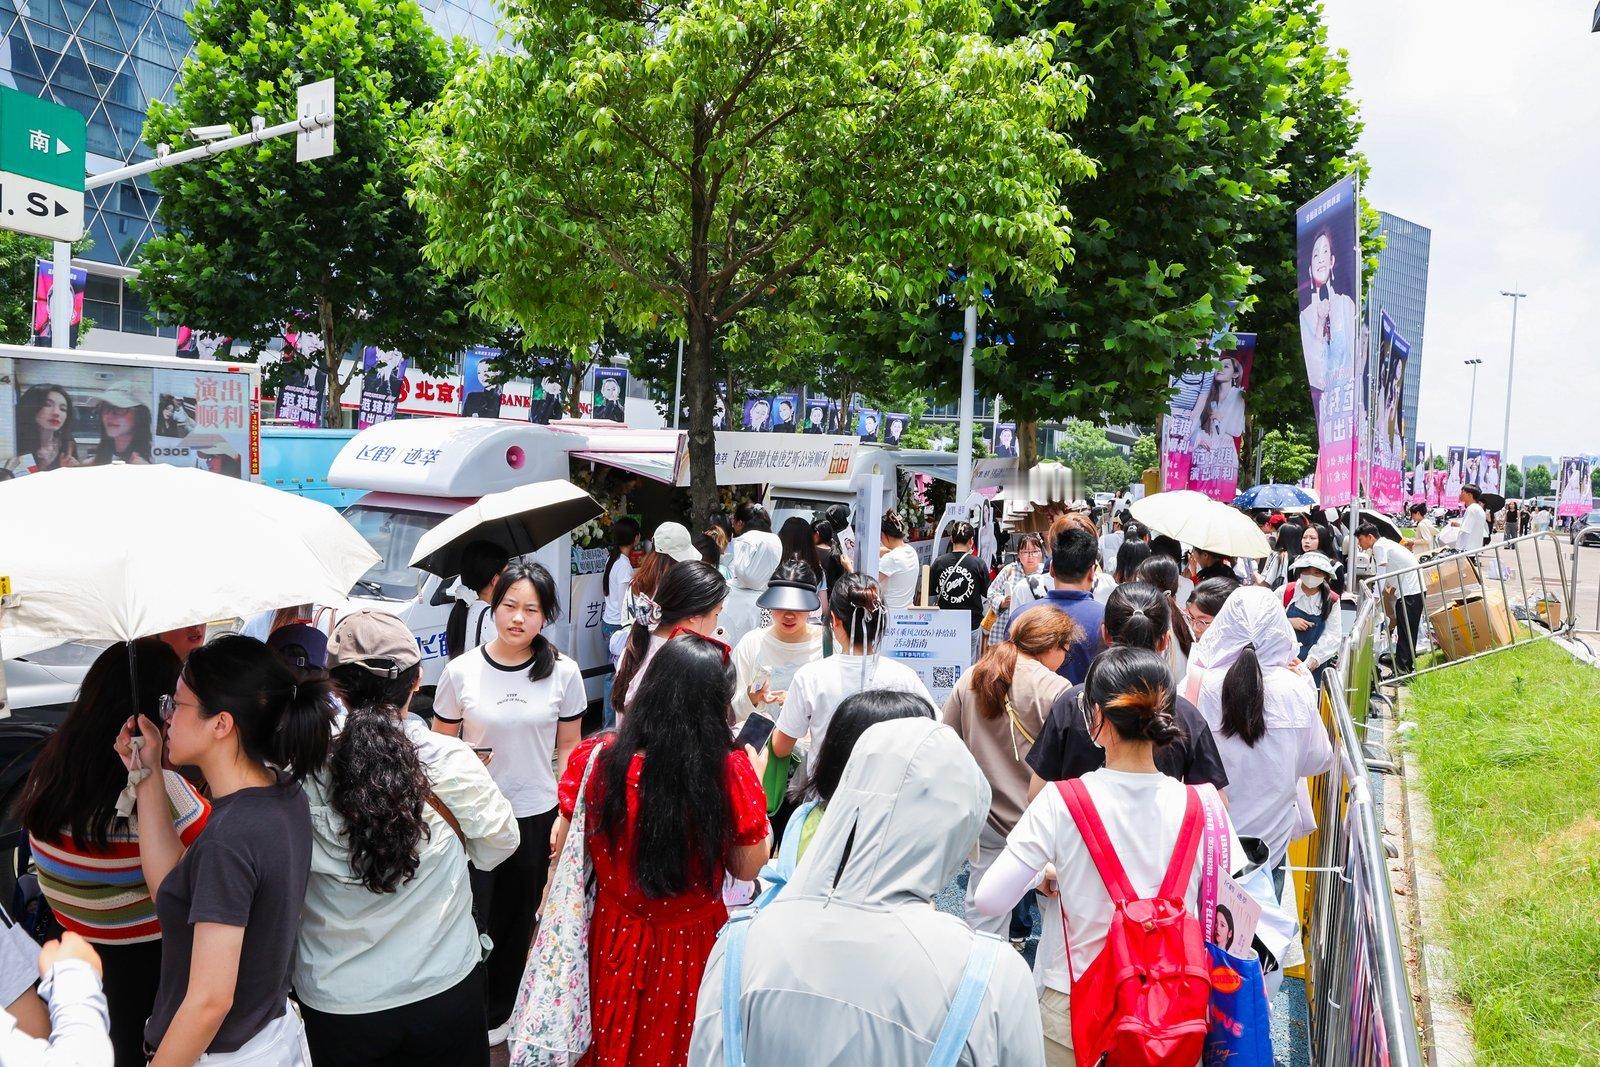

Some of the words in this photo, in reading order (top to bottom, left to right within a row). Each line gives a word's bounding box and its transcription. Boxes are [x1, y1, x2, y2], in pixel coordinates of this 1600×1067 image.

[29, 129, 51, 154] 南
[27, 192, 49, 217] S
[194, 377, 243, 403] 演出
[415, 380, 464, 404] 北京
[500, 394, 531, 409] BANK
[194, 405, 243, 429] 顺利
[153, 448, 190, 457] 0305
[356, 445, 396, 463] 飞鹤
[894, 639, 928, 649] 活动指南
[1205, 899, 1214, 943] 7-ELEVEN
